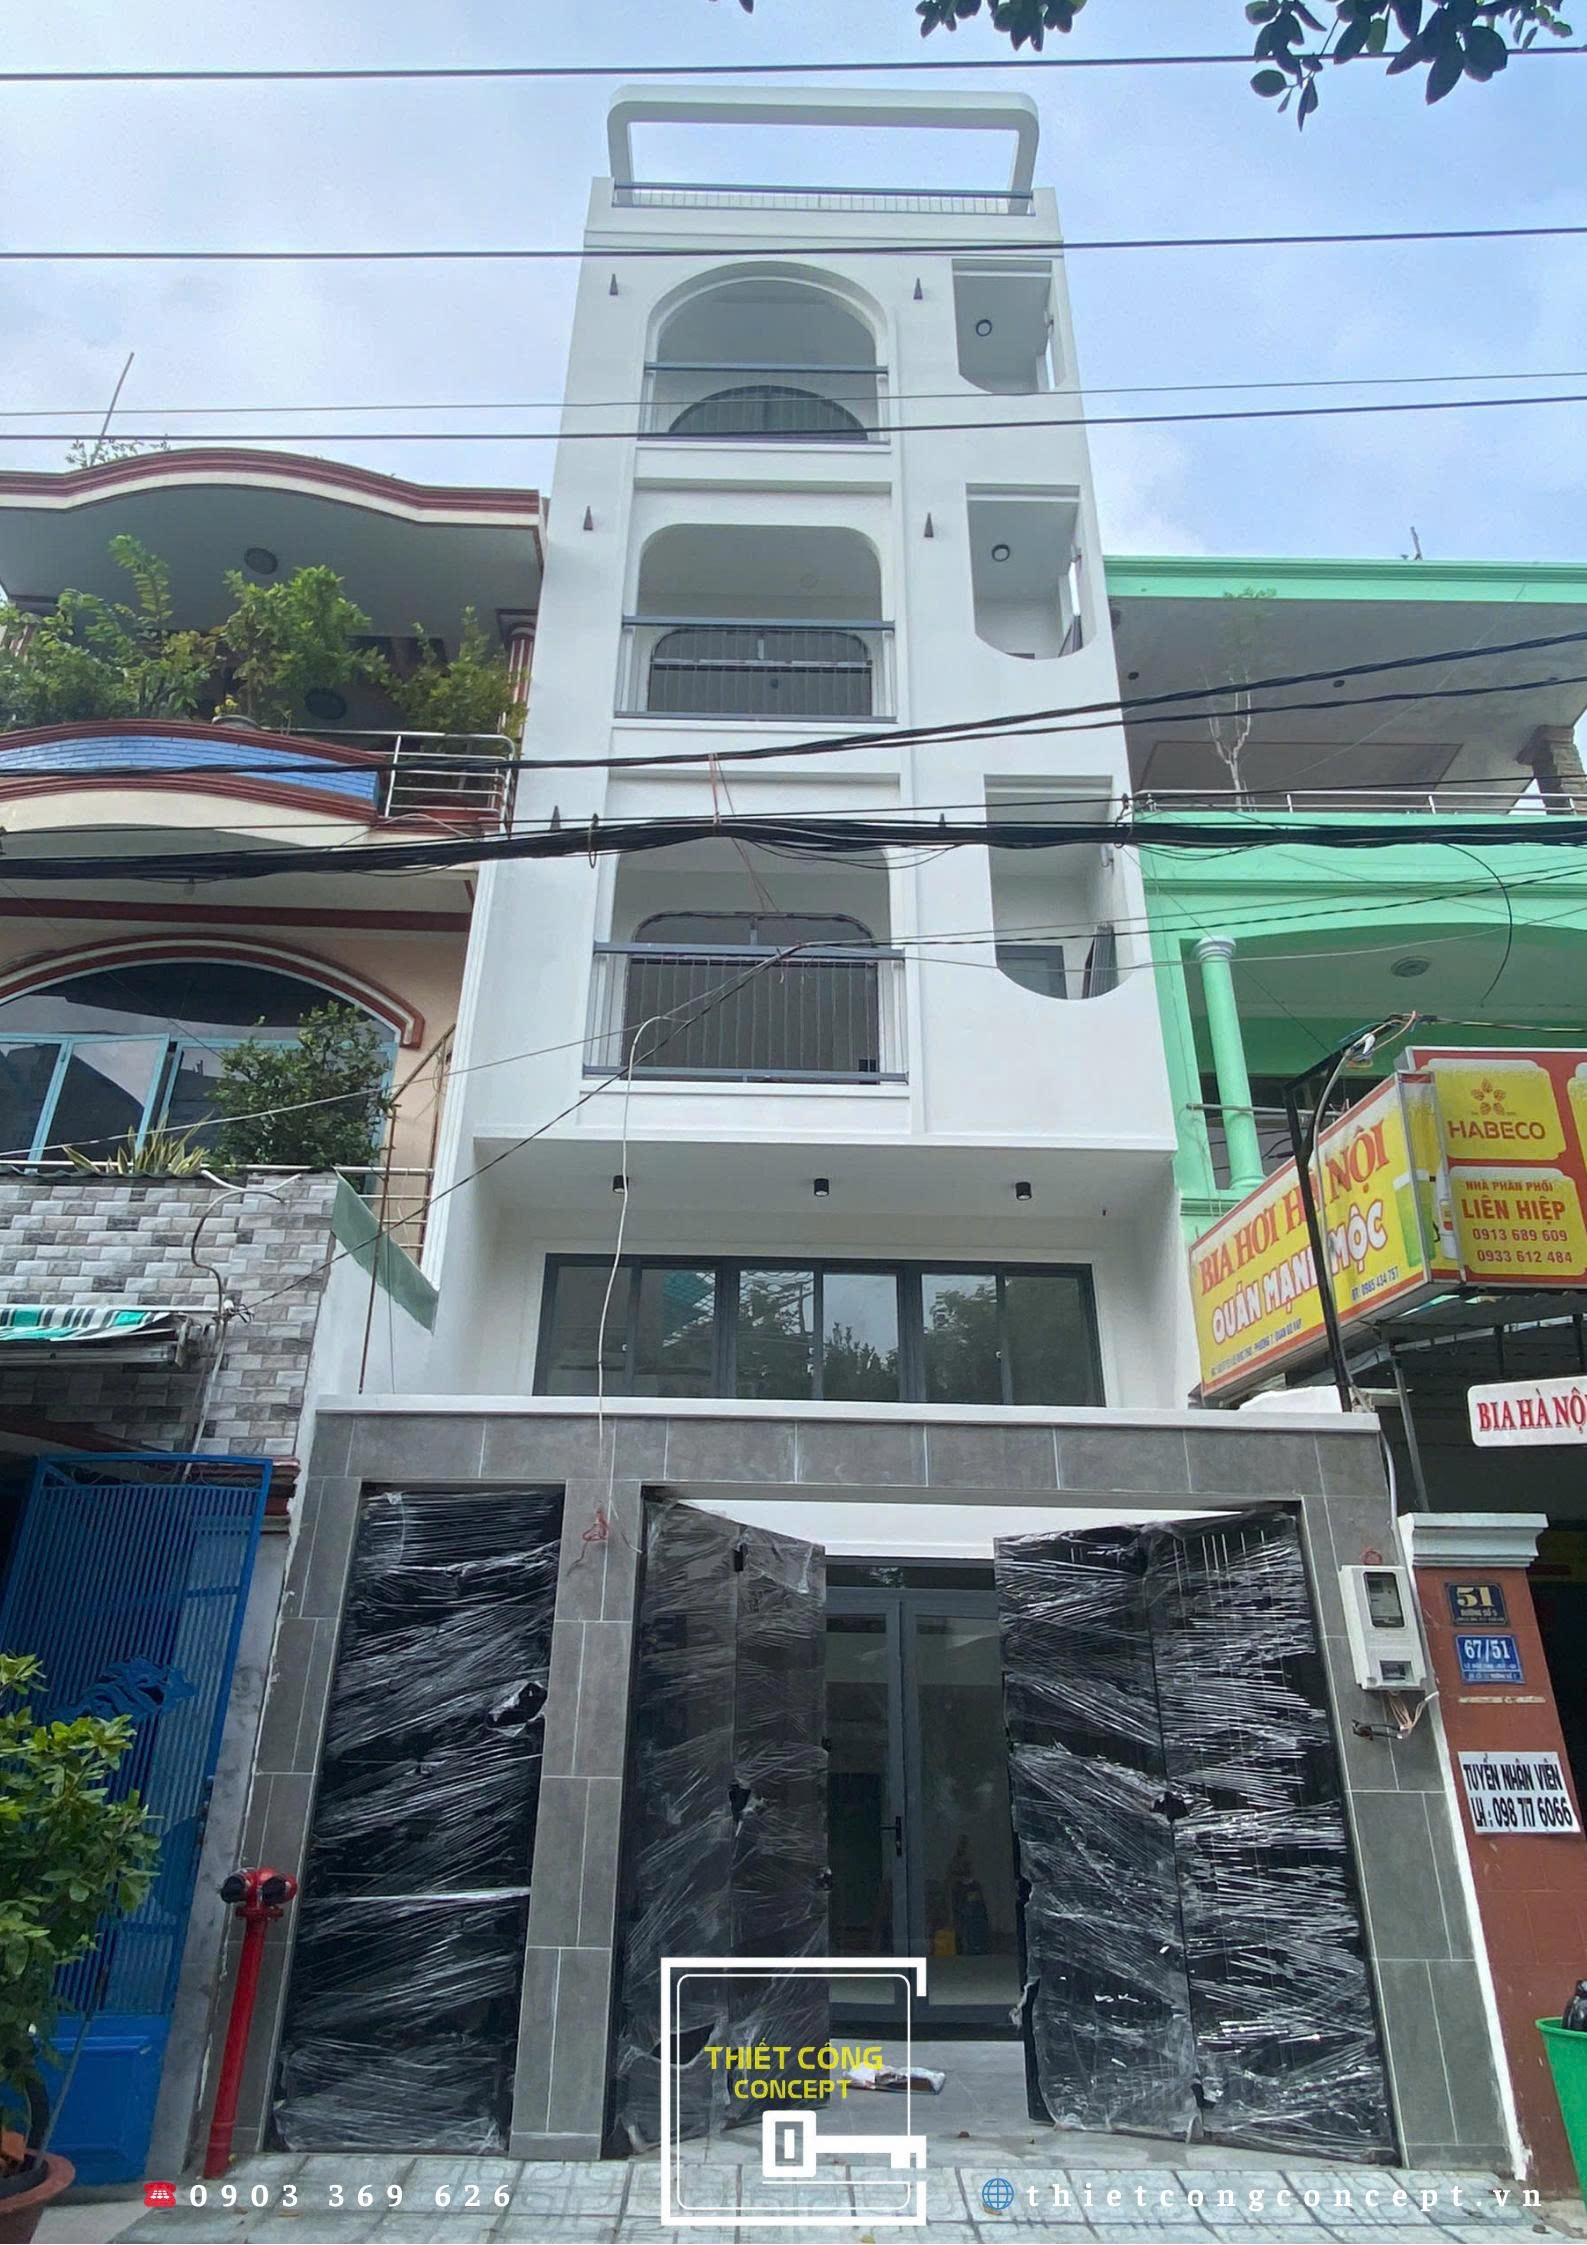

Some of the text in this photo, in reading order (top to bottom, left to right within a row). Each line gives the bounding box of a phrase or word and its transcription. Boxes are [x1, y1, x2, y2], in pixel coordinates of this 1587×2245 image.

[1448, 1120, 1546, 1140] HABECO
[1465, 1180, 1489, 1192] NHÀ
[1199, 1242, 1236, 1296] BIA
[1325, 1119, 1390, 1204] NỘI
[1461, 1194, 1566, 1226] LIÊN HIỆP
[1472, 1228, 1568, 1242] 0913 689 609
[1477, 1249, 1573, 1264] 0933 612 484
[1212, 1280, 1261, 1345] QUÁN
[1326, 1199, 1388, 1276] MỘC
[1477, 1386, 1587, 1434] BIA HÀ NỘ
[1457, 1587, 1495, 1606] 51
[1464, 1639, 1510, 1662] 67/51
[1463, 1753, 1563, 1791] TUYỂN NHÂN VIÊN
[1492, 1797, 1518, 1827] 098
[1537, 1797, 1573, 1827] 6066
